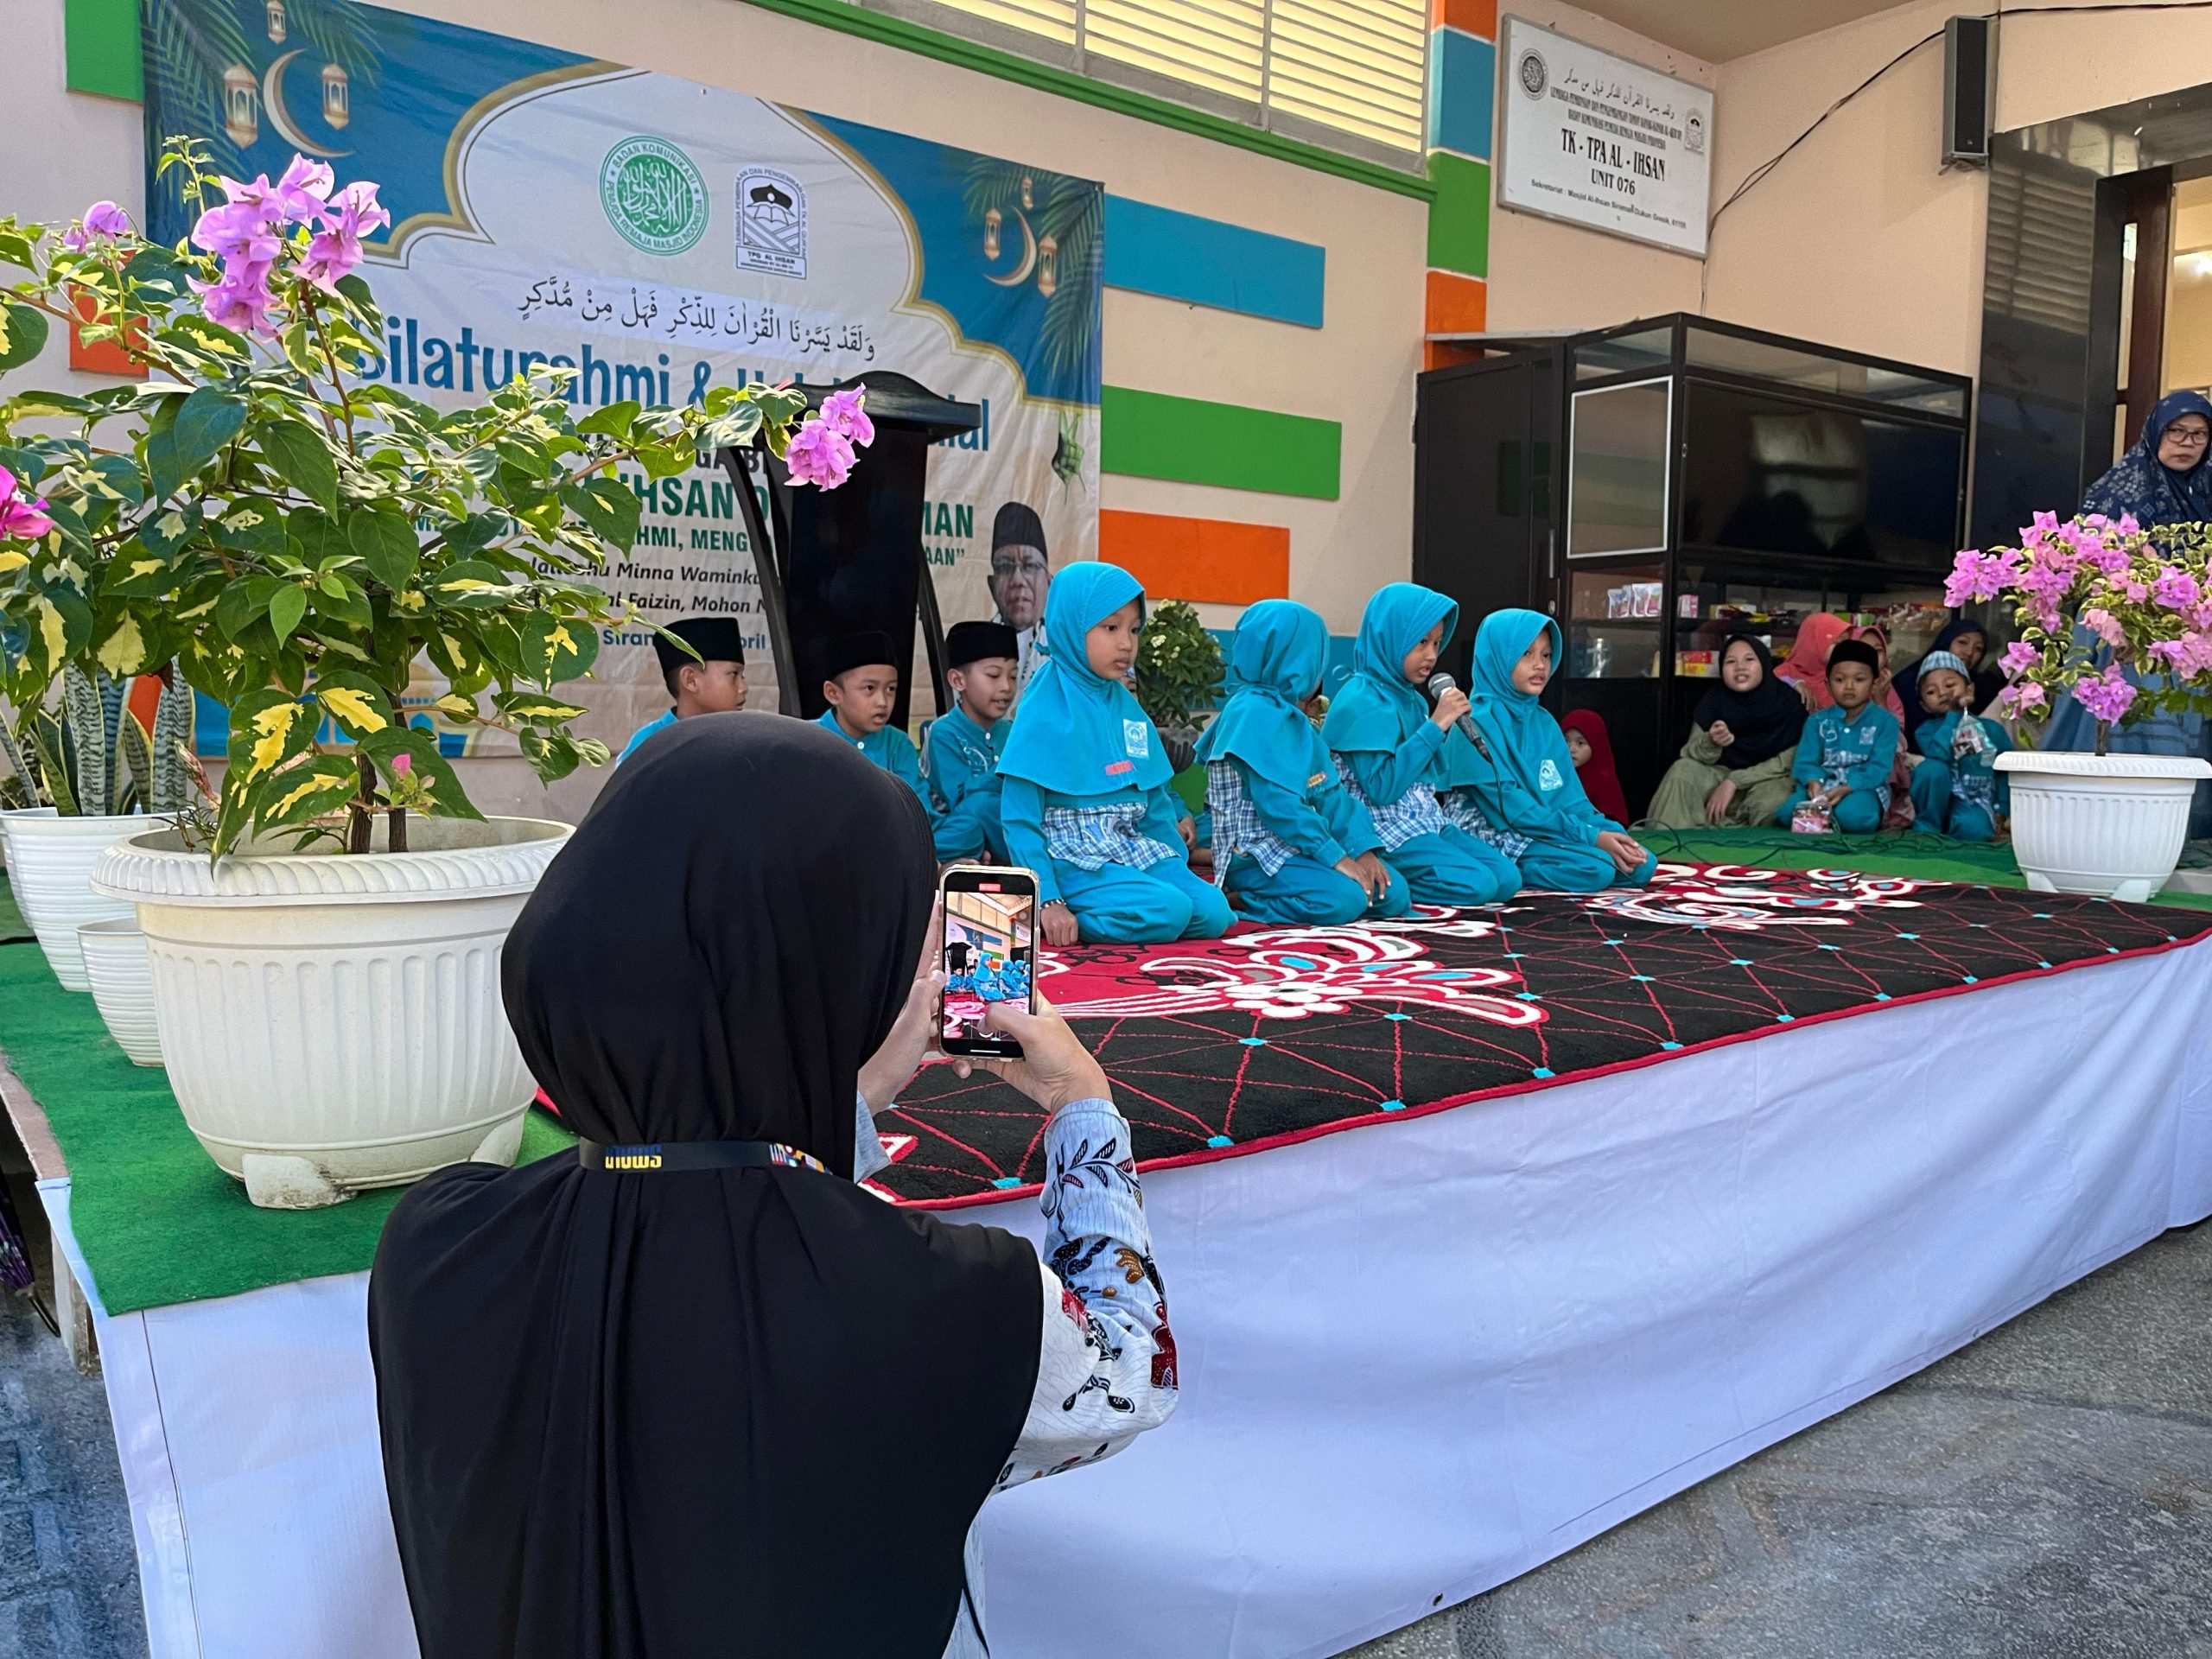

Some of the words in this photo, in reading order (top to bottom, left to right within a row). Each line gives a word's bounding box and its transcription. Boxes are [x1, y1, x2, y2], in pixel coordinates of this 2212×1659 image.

[613, 144, 640, 168] BADAN
[641, 143, 698, 184] KOMUNIKASI
[1561, 128, 1576, 154] TK
[1587, 137, 1606, 164] TPA
[1609, 144, 1623, 168] AL
[1633, 150, 1666, 181] IHSAN
[1592, 168, 1614, 189] UNIT
[1617, 176, 1636, 195] 076
[607, 181, 622, 221] PEMUDA
[620, 219, 652, 246] REMAJA
[653, 236, 683, 249] MASJID
[682, 200, 702, 240] INDONESIA
[688, 361, 712, 411] &
[620, 474, 733, 519] HSAN
[691, 529, 748, 552] MENG
[617, 563, 674, 581] Minna
[681, 566, 760, 585] Waminku
[630, 592, 685, 613] Faizin,
[692, 596, 751, 613] Mohon
